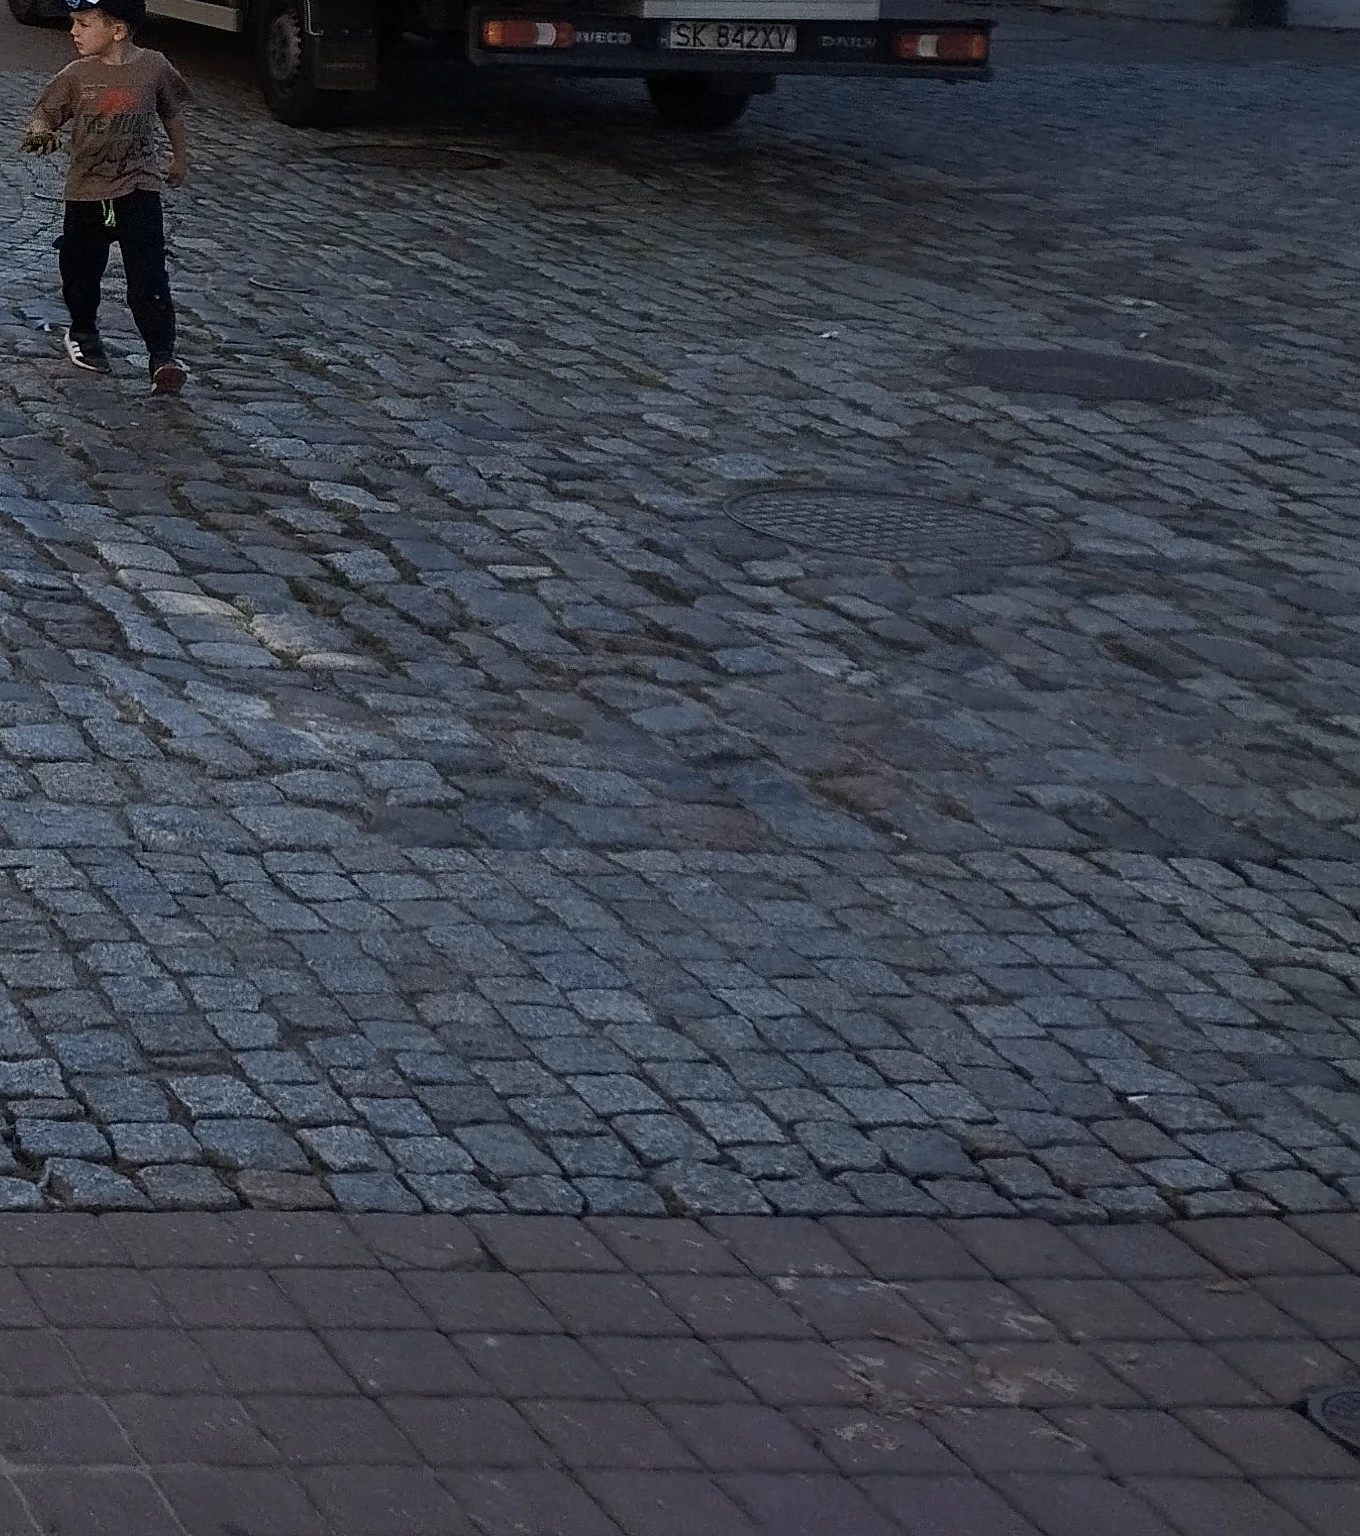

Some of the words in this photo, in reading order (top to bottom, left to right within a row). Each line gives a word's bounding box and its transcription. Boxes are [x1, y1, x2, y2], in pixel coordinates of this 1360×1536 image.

[575, 31, 632, 45] IVECO
[675, 23, 706, 48] SK
[716, 24, 790, 50] 842XV
